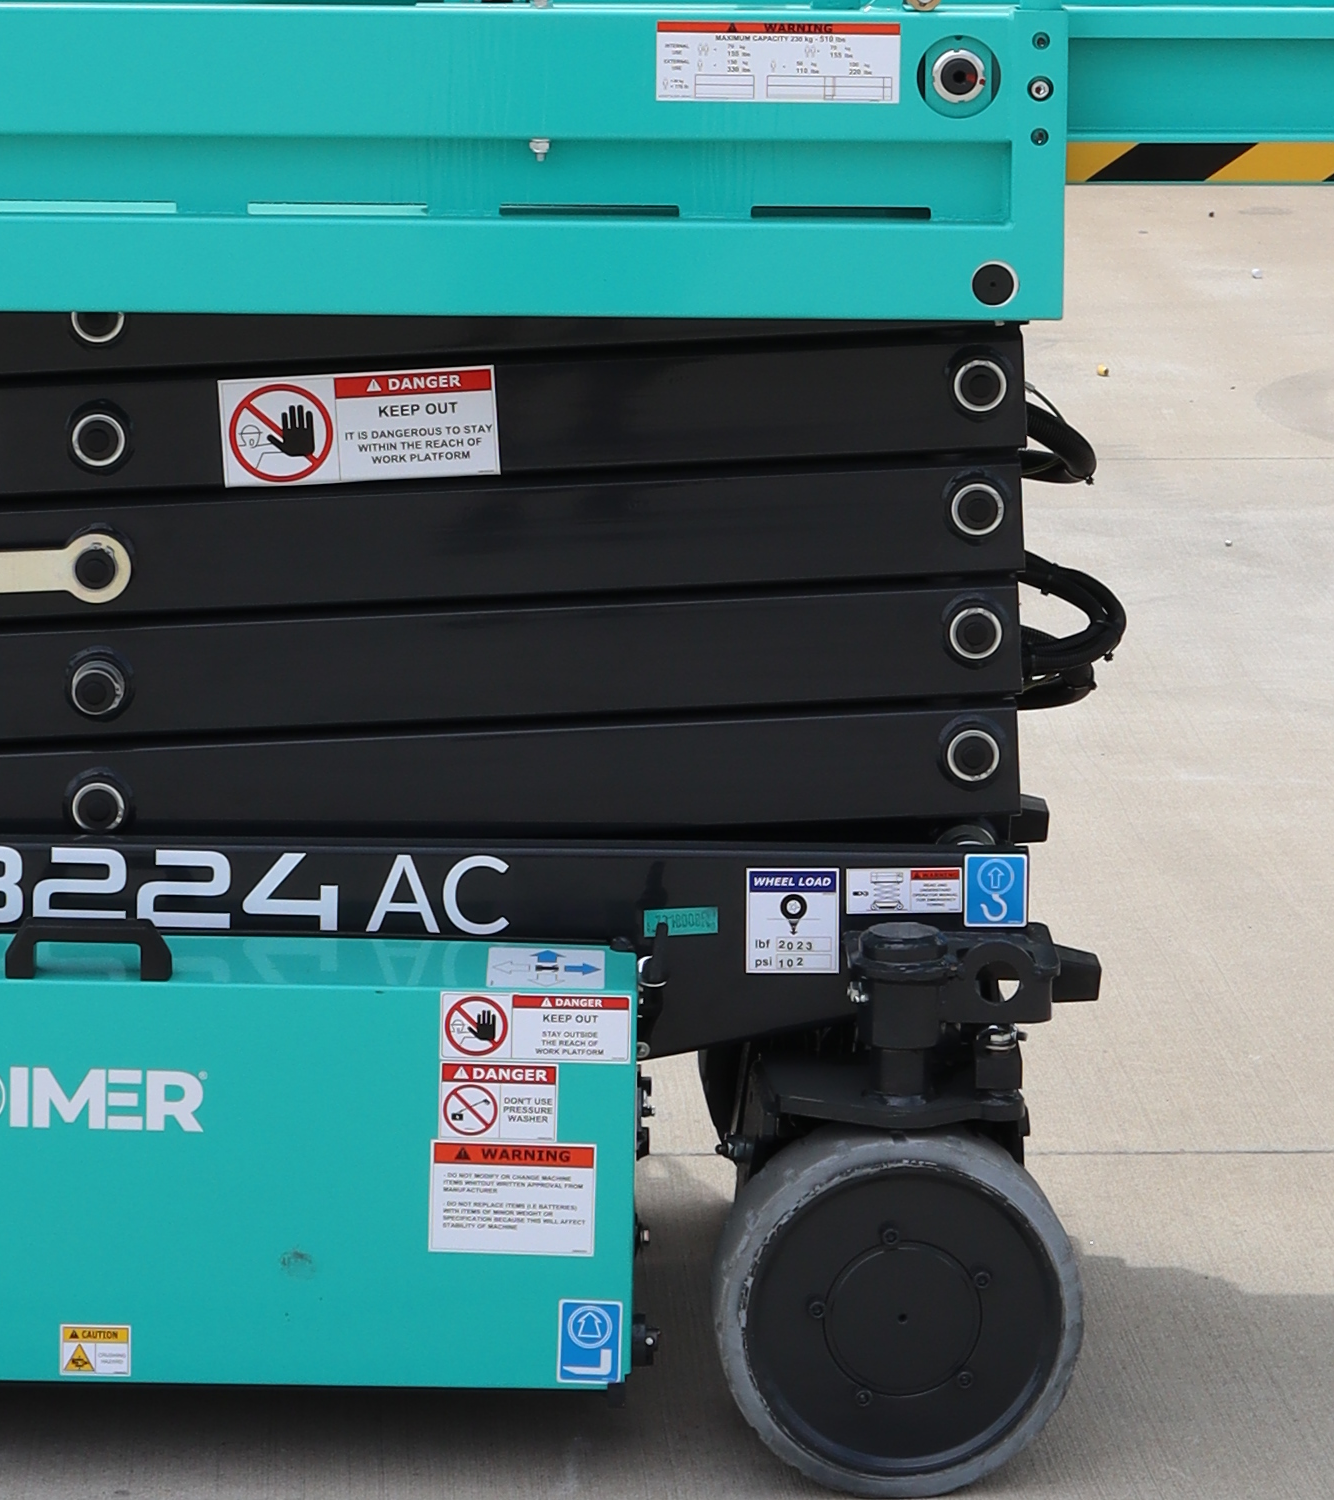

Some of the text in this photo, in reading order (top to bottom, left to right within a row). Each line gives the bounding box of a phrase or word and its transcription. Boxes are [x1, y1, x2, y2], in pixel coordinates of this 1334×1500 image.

[763, 23, 833, 33] WARNING
[388, 374, 461, 391] DANGER
[378, 401, 458, 417] KEEP OUT
[345, 424, 492, 441] IT IS DANGEROUS TO STAY
[357, 437, 482, 452] WITHIN THE REACH OF
[371, 451, 470, 464] WORK PLATFORM
[754, 877, 831, 887] WHEEL LOAD
[364, 854, 510, 934] AC
[755, 939, 812, 950] lbf 2023
[755, 957, 803, 968] psi 102
[555, 998, 603, 1007] DANGER
[543, 1014, 598, 1023] KEEP OUT
[472, 1068, 548, 1082] DANGER
[9, 1067, 204, 1133] IMER
[504, 1097, 532, 1105] DON'T
[503, 1106, 553, 1114] PRESSURE
[508, 1115, 548, 1123] WASHER
[481, 1148, 571, 1162] WARNING
[82, 1330, 118, 1339] CAUTION
